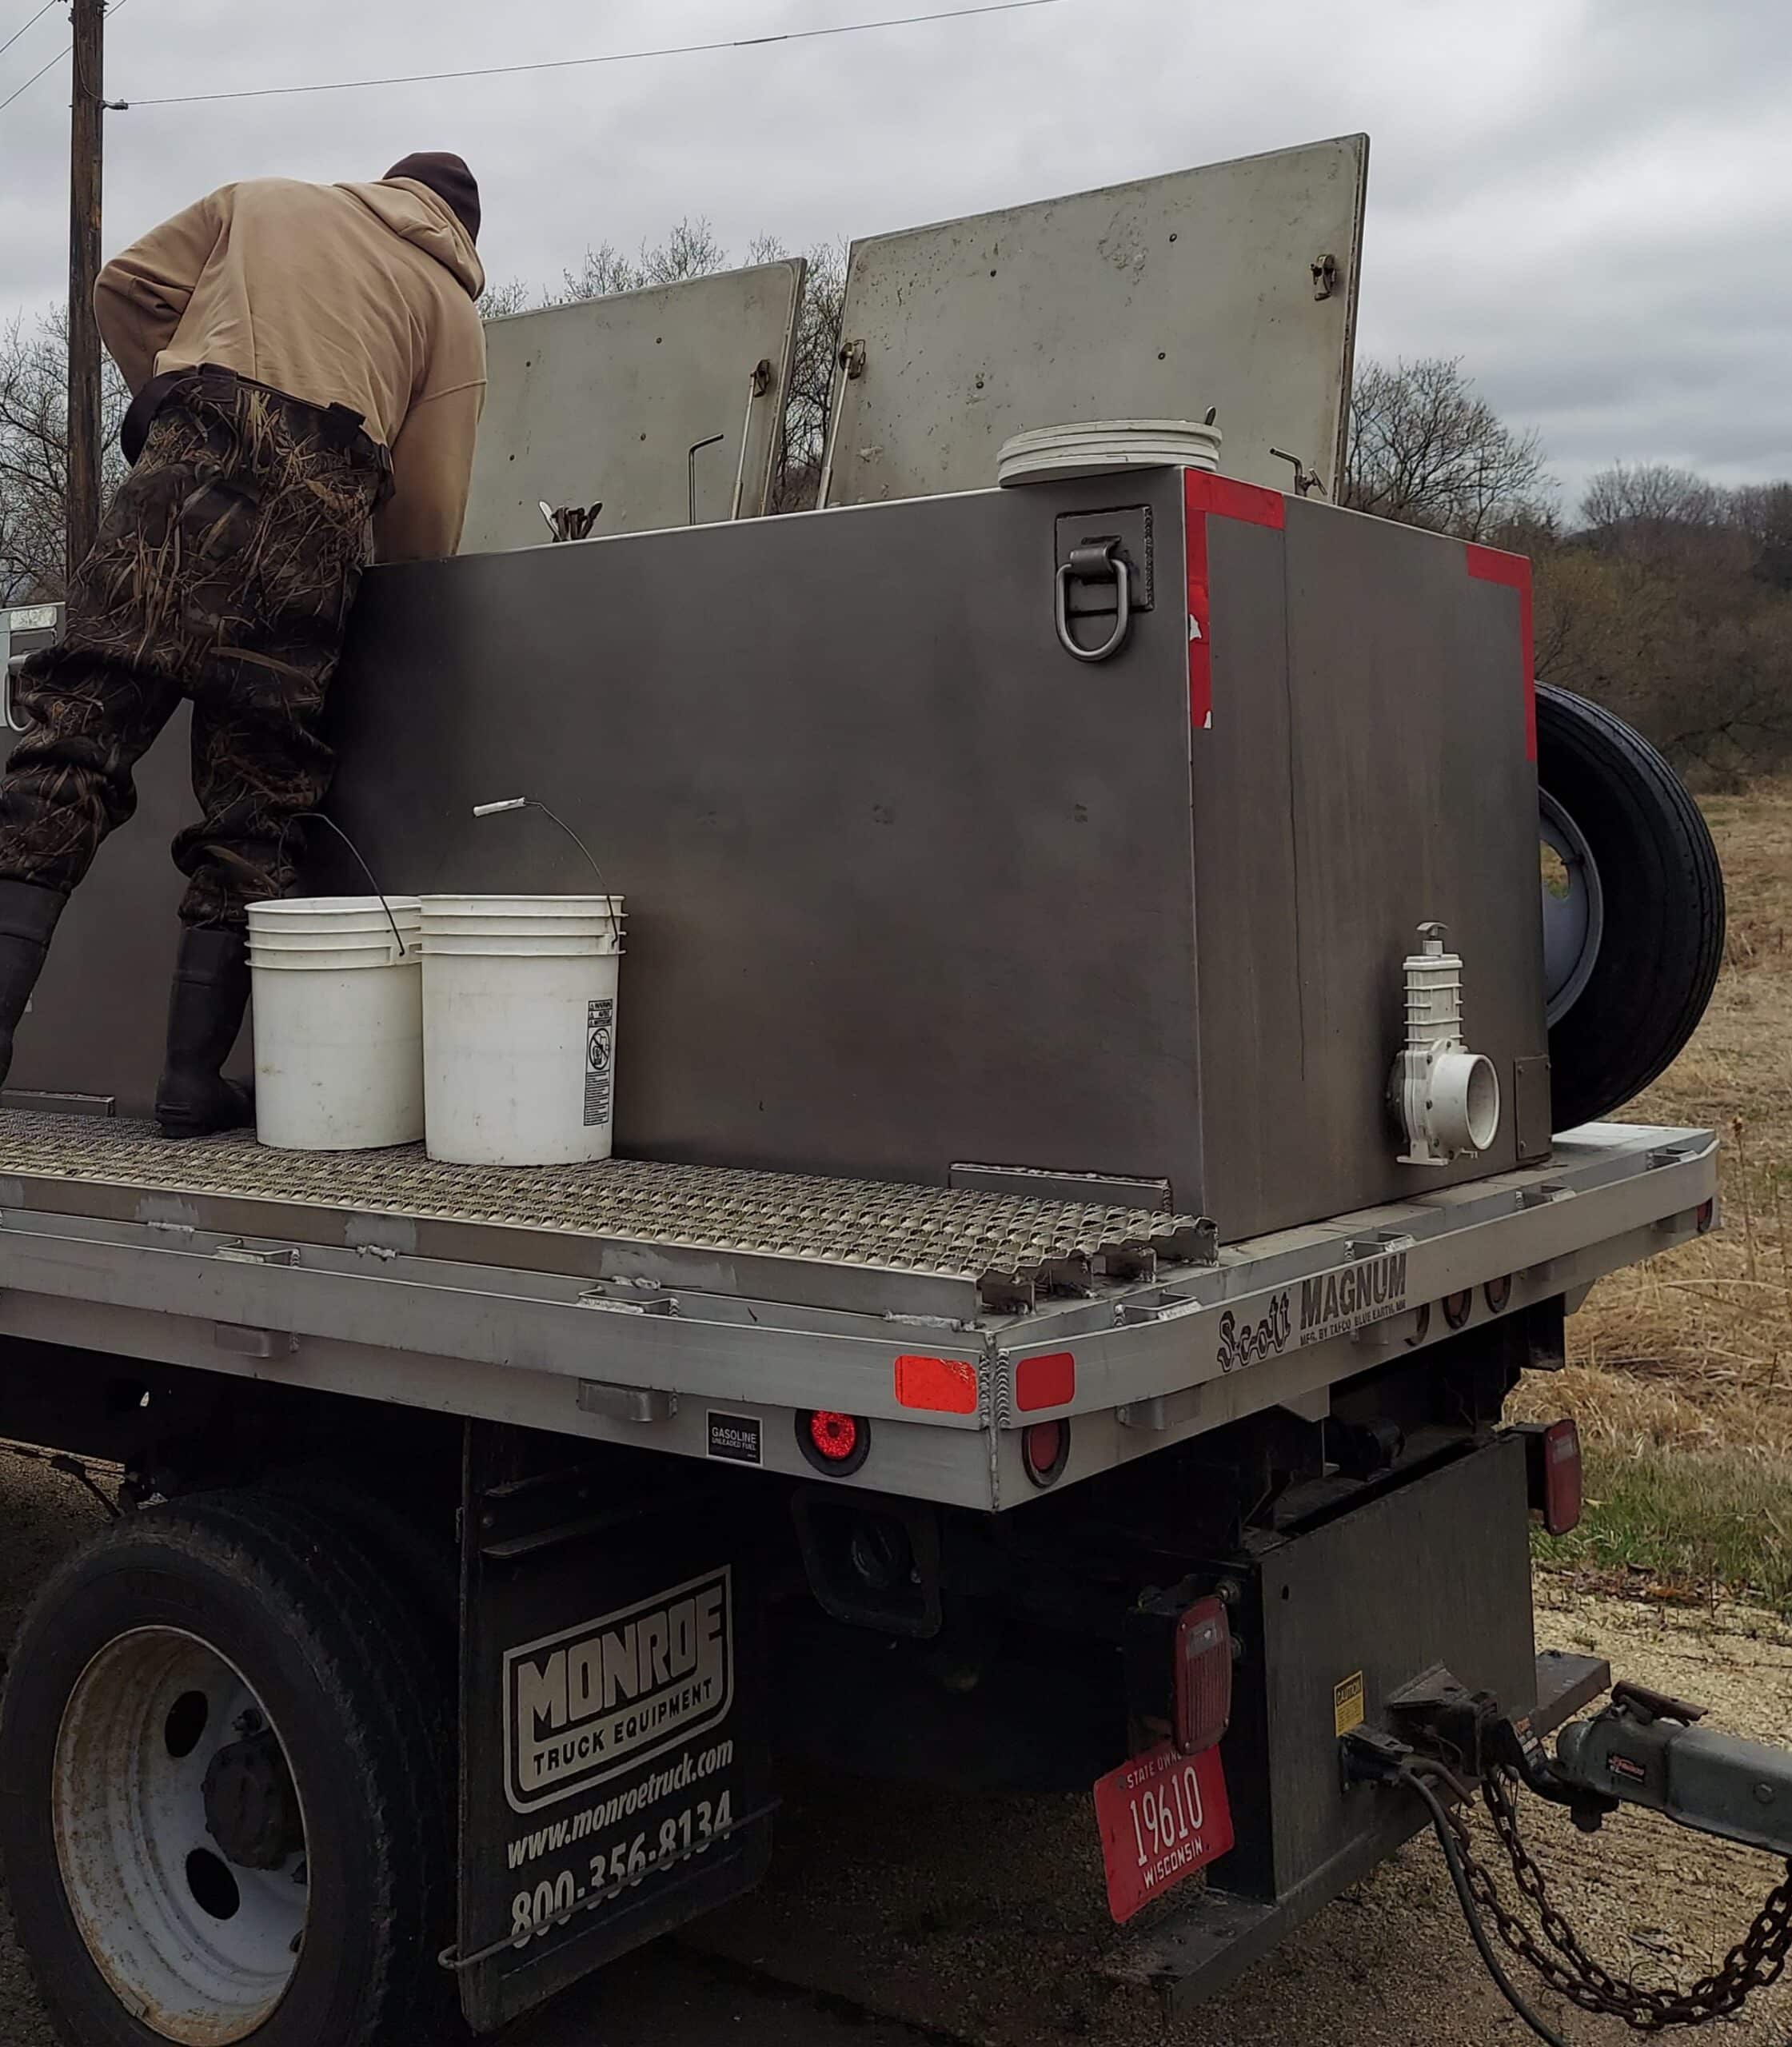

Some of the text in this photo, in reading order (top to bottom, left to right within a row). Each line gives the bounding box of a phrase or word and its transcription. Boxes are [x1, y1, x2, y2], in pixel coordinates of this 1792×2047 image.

[1300, 1252, 1407, 1330] MAGNUM
[1319, 1327, 1328, 1340] BY
[1330, 1319, 1351, 1335] TAFCO
[1355, 1312, 1371, 1326] BLUE
[1216, 1291, 1291, 1373] Scott
[711, 1427, 757, 1444] GASOLINE
[711, 1437, 756, 1451] UNLEADED FUEL
[517, 1586, 723, 1730] MONROE
[533, 1677, 713, 1777] TRUCK EQUIPMENT
[507, 1738, 734, 1869] www.monroetruck.com
[1127, 1761, 1155, 1790] STATE
[1129, 1766, 1203, 1867] 19610
[511, 1790, 733, 1949] 800-356-8134
[1143, 1835, 1203, 1889] WISCONSIN
